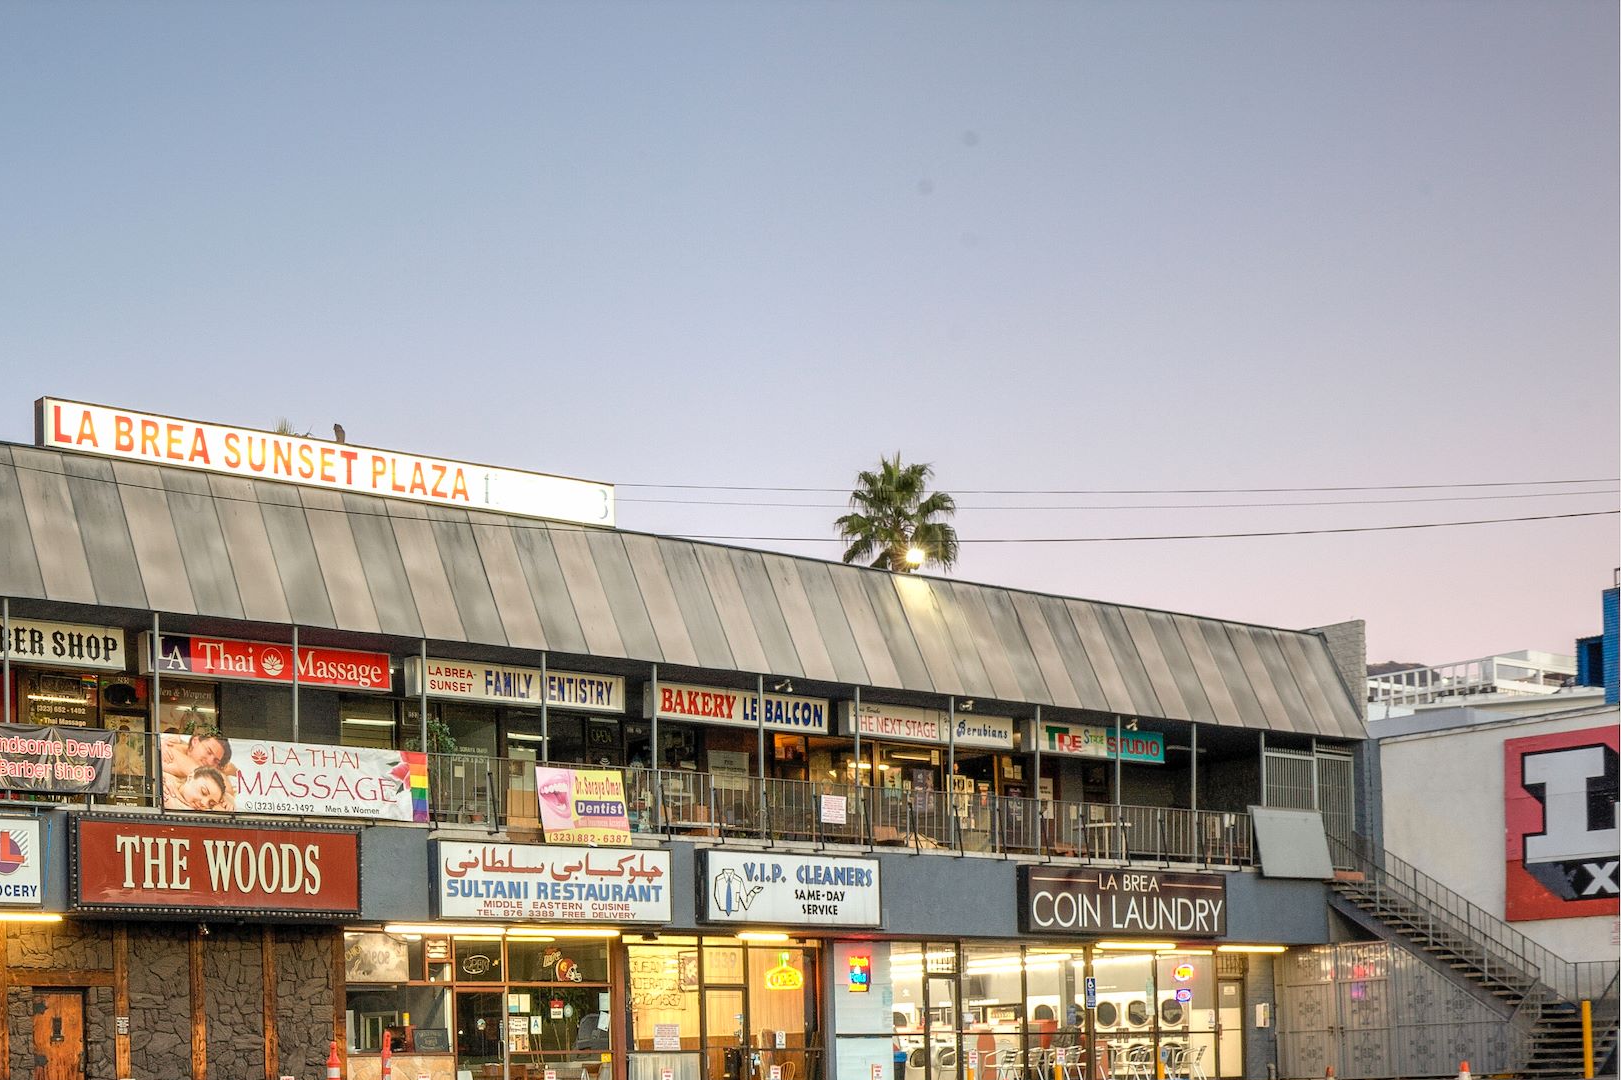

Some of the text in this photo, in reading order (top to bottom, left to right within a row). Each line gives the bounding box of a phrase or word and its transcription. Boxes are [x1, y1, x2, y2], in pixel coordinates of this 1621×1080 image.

[53, 405, 98, 447] LA
[115, 415, 210, 465] BREA
[224, 432, 358, 485] SUNSET
[371, 455, 469, 501] PLAZA
[52, 630, 118, 662] SHOP
[157, 636, 383, 688] LA Thai Massage
[428, 665, 443, 677] LA
[429, 679, 473, 693] SUNSET
[484, 669, 613, 707] FAMILY ENTISTRY
[36, 704, 53, 713] (323)
[660, 687, 823, 728] BAKERY LE BALCON
[876, 717, 936, 739] NEXT STAGE
[66, 738, 113, 760] Devils
[1106, 736, 1160, 757] STUDIO
[271, 745, 361, 770] LA THAI
[54, 762, 96, 783] Shop
[236, 769, 398, 803] MASSAGE
[584, 776, 605, 800] Soraya
[606, 776, 621, 796] Omar
[254, 800, 315, 813] (323) 652-1492
[325, 804, 379, 815] Men & Women
[577, 801, 623, 815] Dentist
[549, 833, 628, 843] (323) 882 6387
[116, 834, 322, 895] THE WOODS
[743, 862, 873, 888] V.I.P. CLEANERS
[446, 879, 663, 903] SULTANI RESTAURANT
[1098, 872, 1160, 893] LA BREA
[483, 900, 631, 911] MIDDLE EASTERN CUISINE
[794, 889, 846, 902] SAME-DAY
[477, 909, 637, 919] TEL. 876 3389 FREE DELIVERY
[802, 904, 838, 916] SERVICE
[1032, 891, 1223, 932] COIN LAUNDRY
